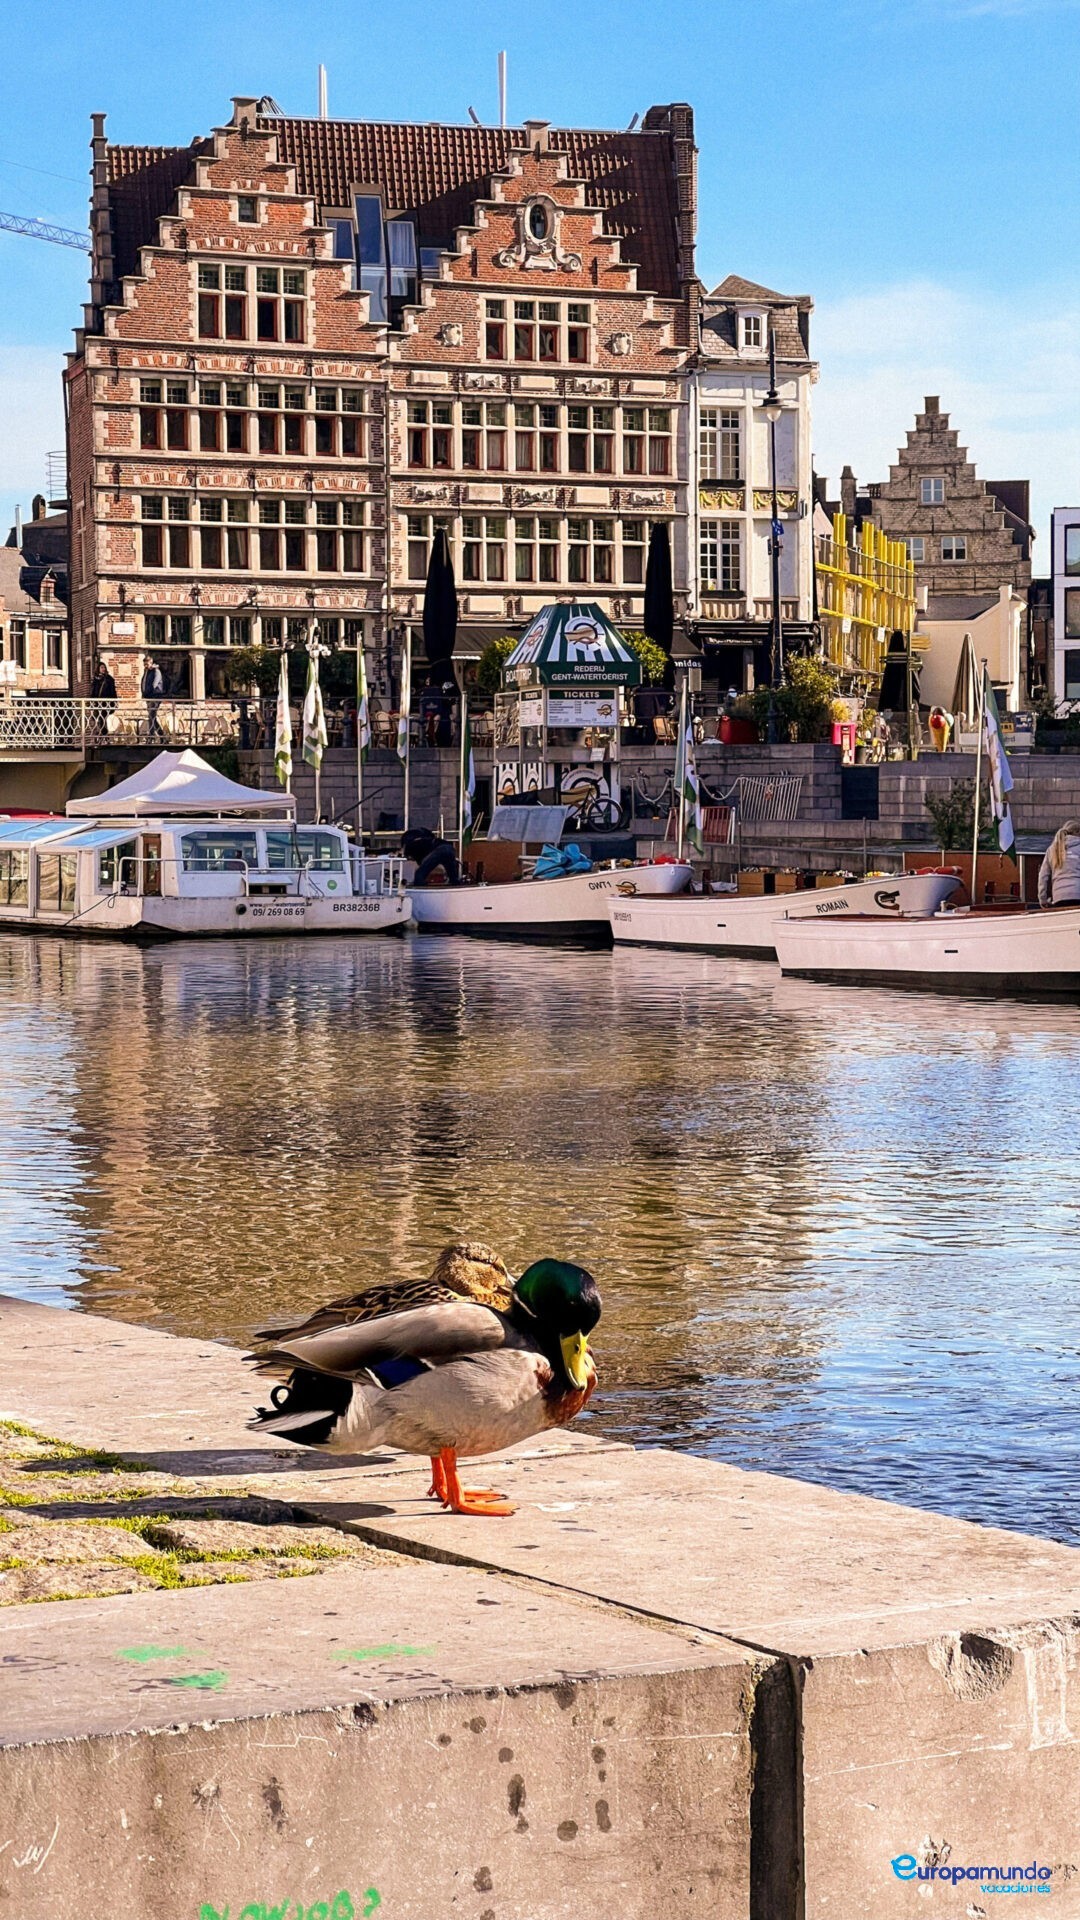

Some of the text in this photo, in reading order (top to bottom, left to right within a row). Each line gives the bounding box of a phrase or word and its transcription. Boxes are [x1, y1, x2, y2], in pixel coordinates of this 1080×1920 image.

[574, 665, 605, 673] REDERIJ
[551, 673, 628, 681] GENT-WATERTOERIST
[588, 881, 612, 890] GWT1
[815, 899, 849, 913] ROMAIN
[267, 908, 282, 916] 269
[283, 908, 294, 916] 08
[295, 908, 305, 916] 69
